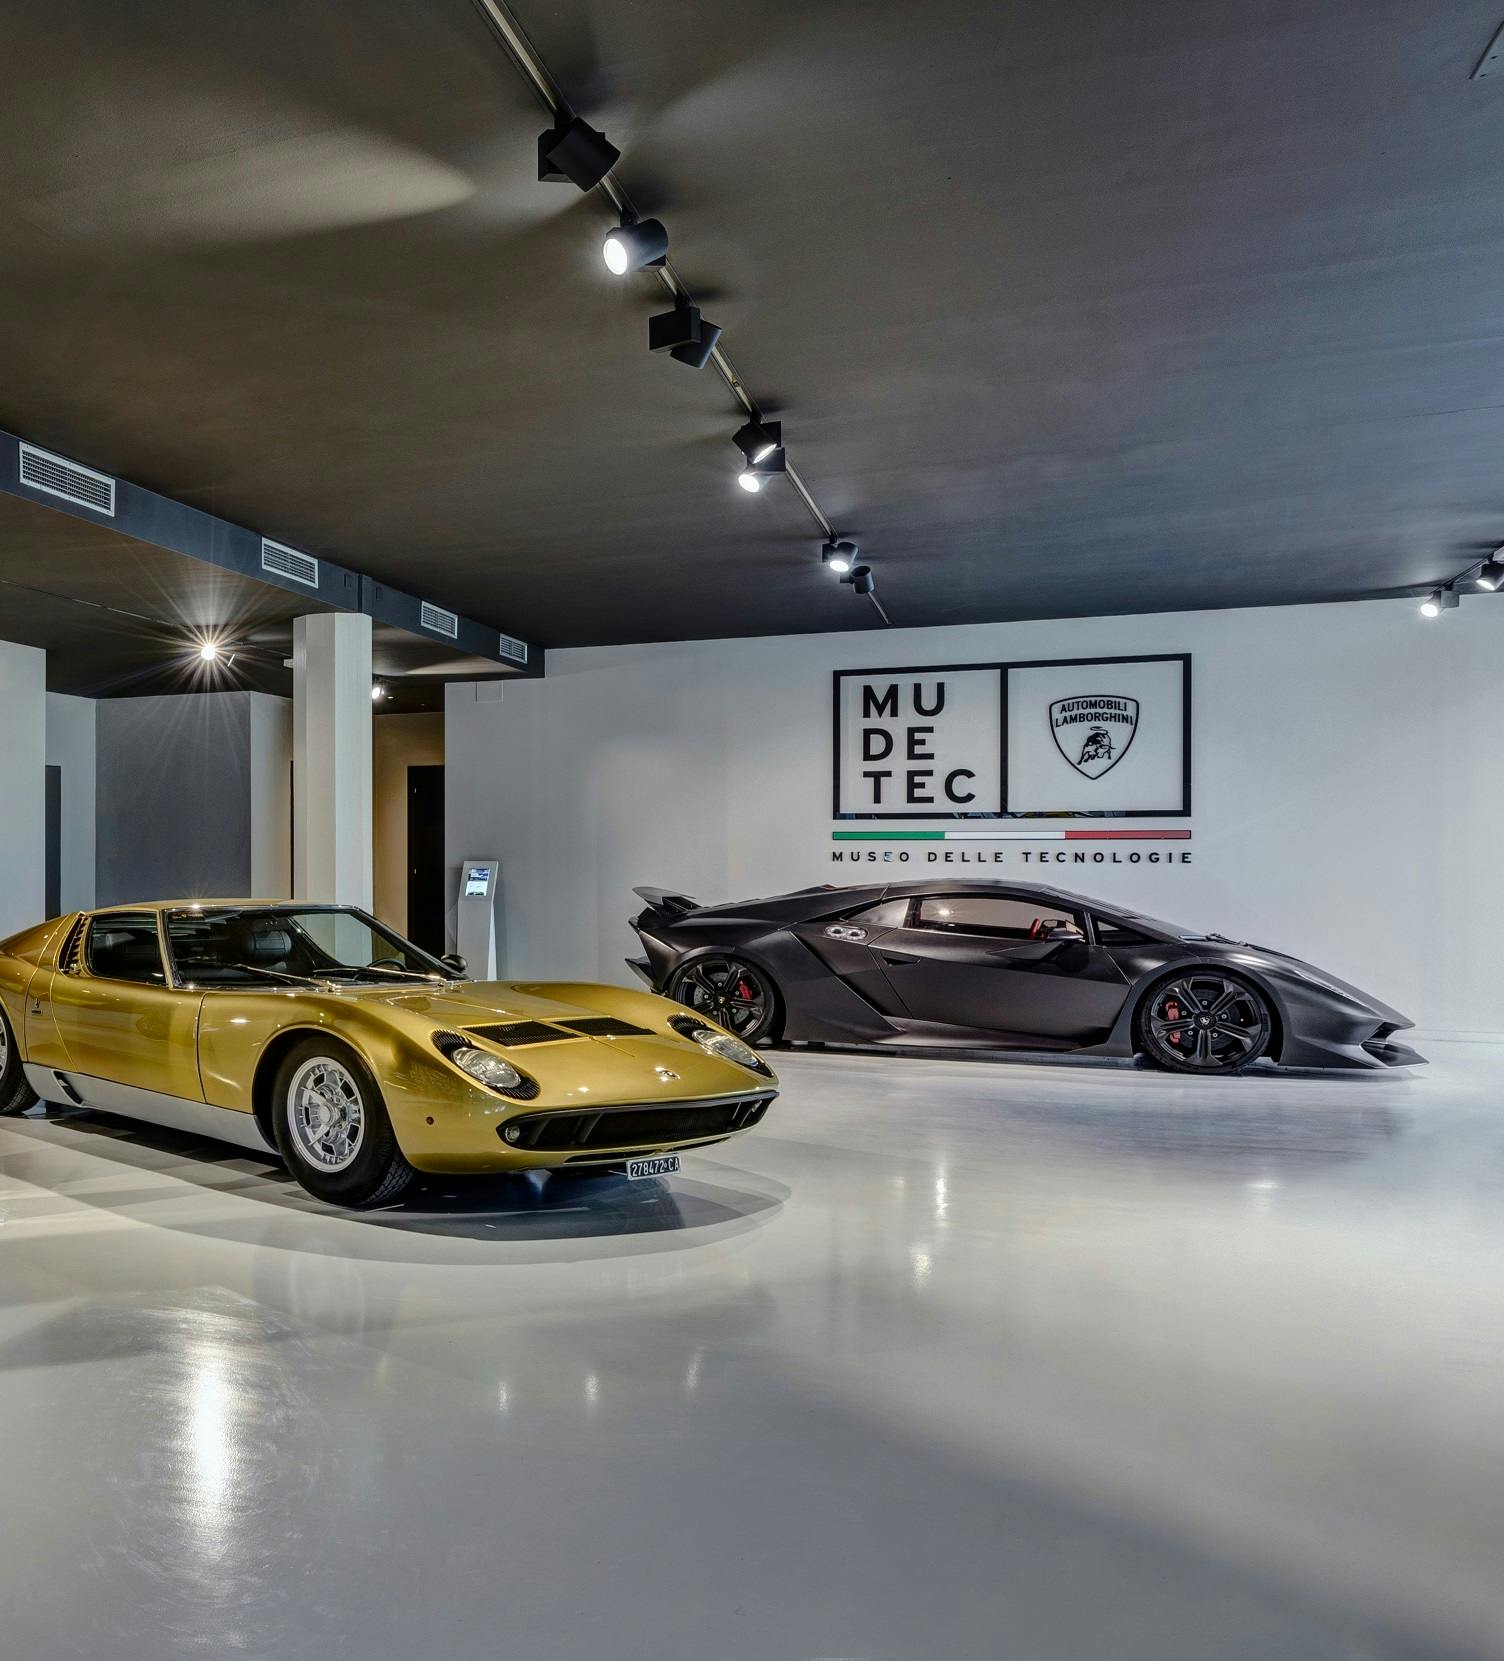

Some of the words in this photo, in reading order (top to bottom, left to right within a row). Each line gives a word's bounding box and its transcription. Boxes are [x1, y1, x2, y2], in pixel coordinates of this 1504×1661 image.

[862, 682, 945, 719] MU
[1059, 699, 1128, 715] AUTOMOBILI
[1054, 711, 1134, 728] LAMBORGHINI
[862, 726, 935, 762] DE
[862, 768, 977, 805] TEC
[832, 851, 910, 864] MUSEO
[928, 851, 1004, 864] DELLE
[1022, 851, 1193, 865] TECNOLOGIE
[631, 1160, 665, 1177] 278472
